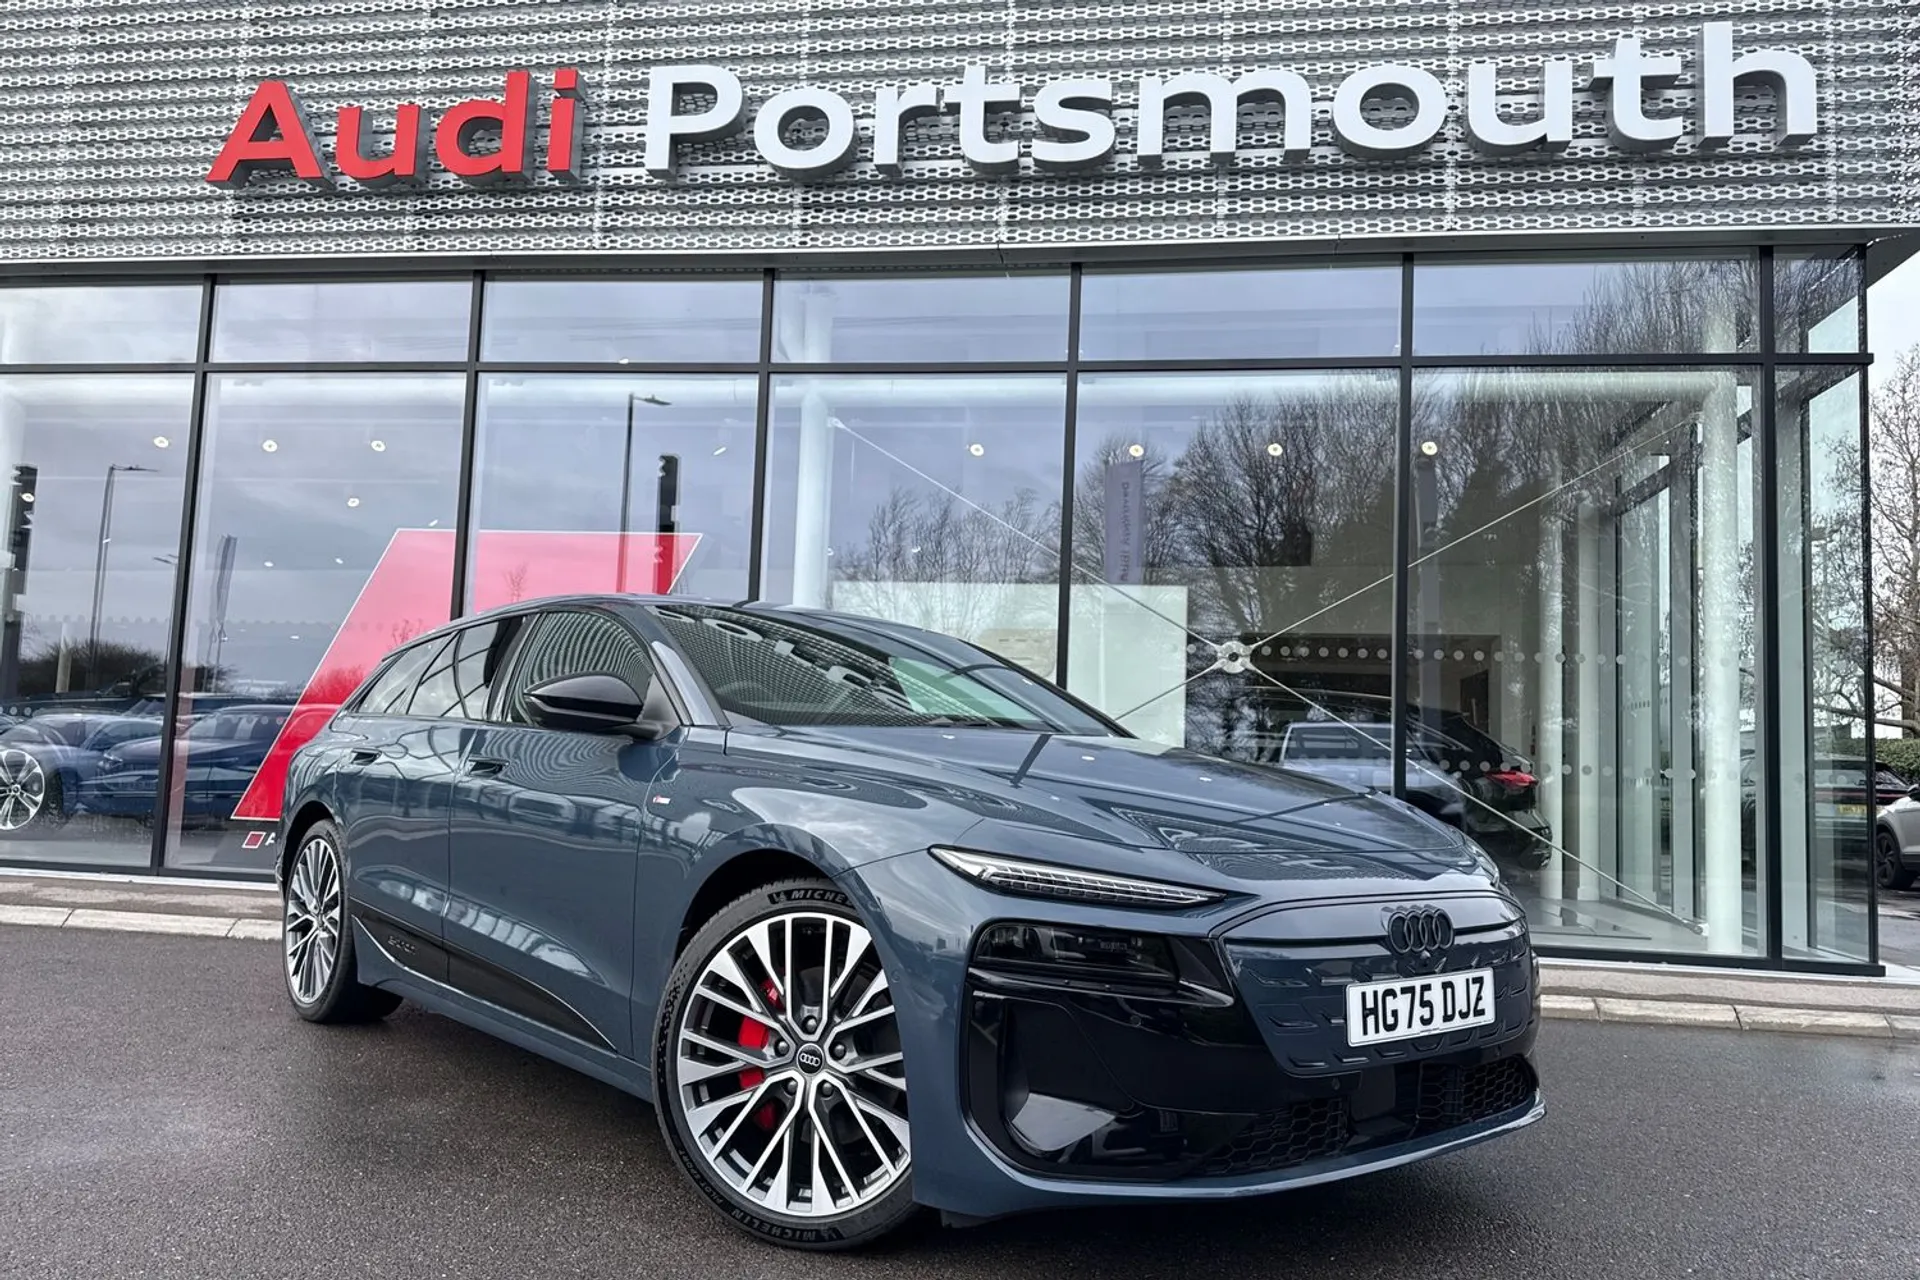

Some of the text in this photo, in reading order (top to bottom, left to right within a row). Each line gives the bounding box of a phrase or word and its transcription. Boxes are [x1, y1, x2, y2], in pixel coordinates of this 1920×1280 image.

[205, 21, 1818, 183] Audi Portsmouth
[1361, 976, 1485, 1036] HG75 DJZ
[731, 1208, 816, 1241] MICHELIN
